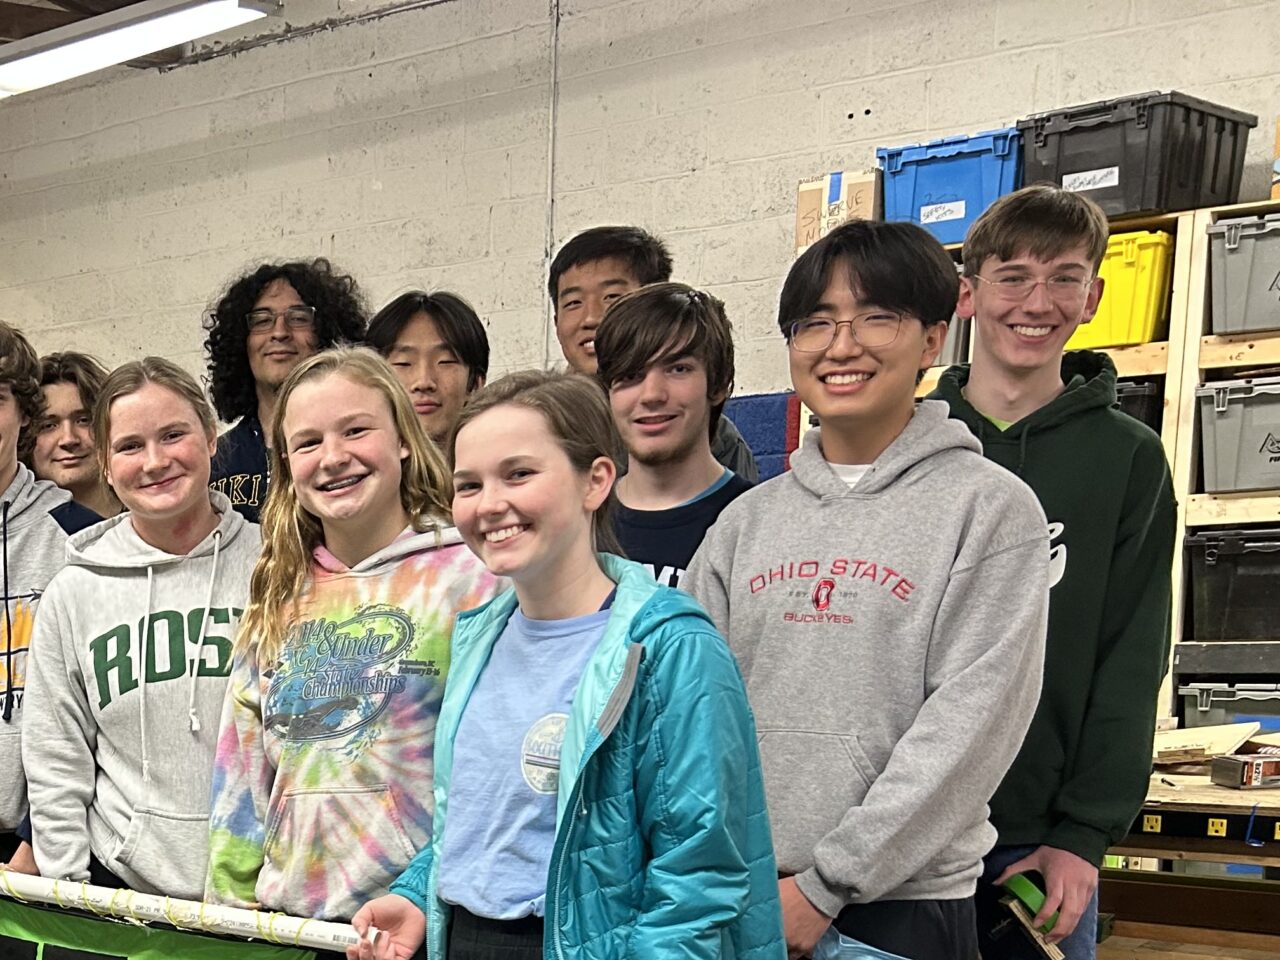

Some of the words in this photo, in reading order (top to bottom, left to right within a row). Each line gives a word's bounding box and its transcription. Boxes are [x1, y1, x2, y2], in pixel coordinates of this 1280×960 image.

[749, 560, 819, 594] OHIO
[830, 558, 916, 604] STATE
[783, 611, 854, 625] BUCKEYES
[332, 629, 394, 659] Under
[302, 672, 407, 700] Championships
